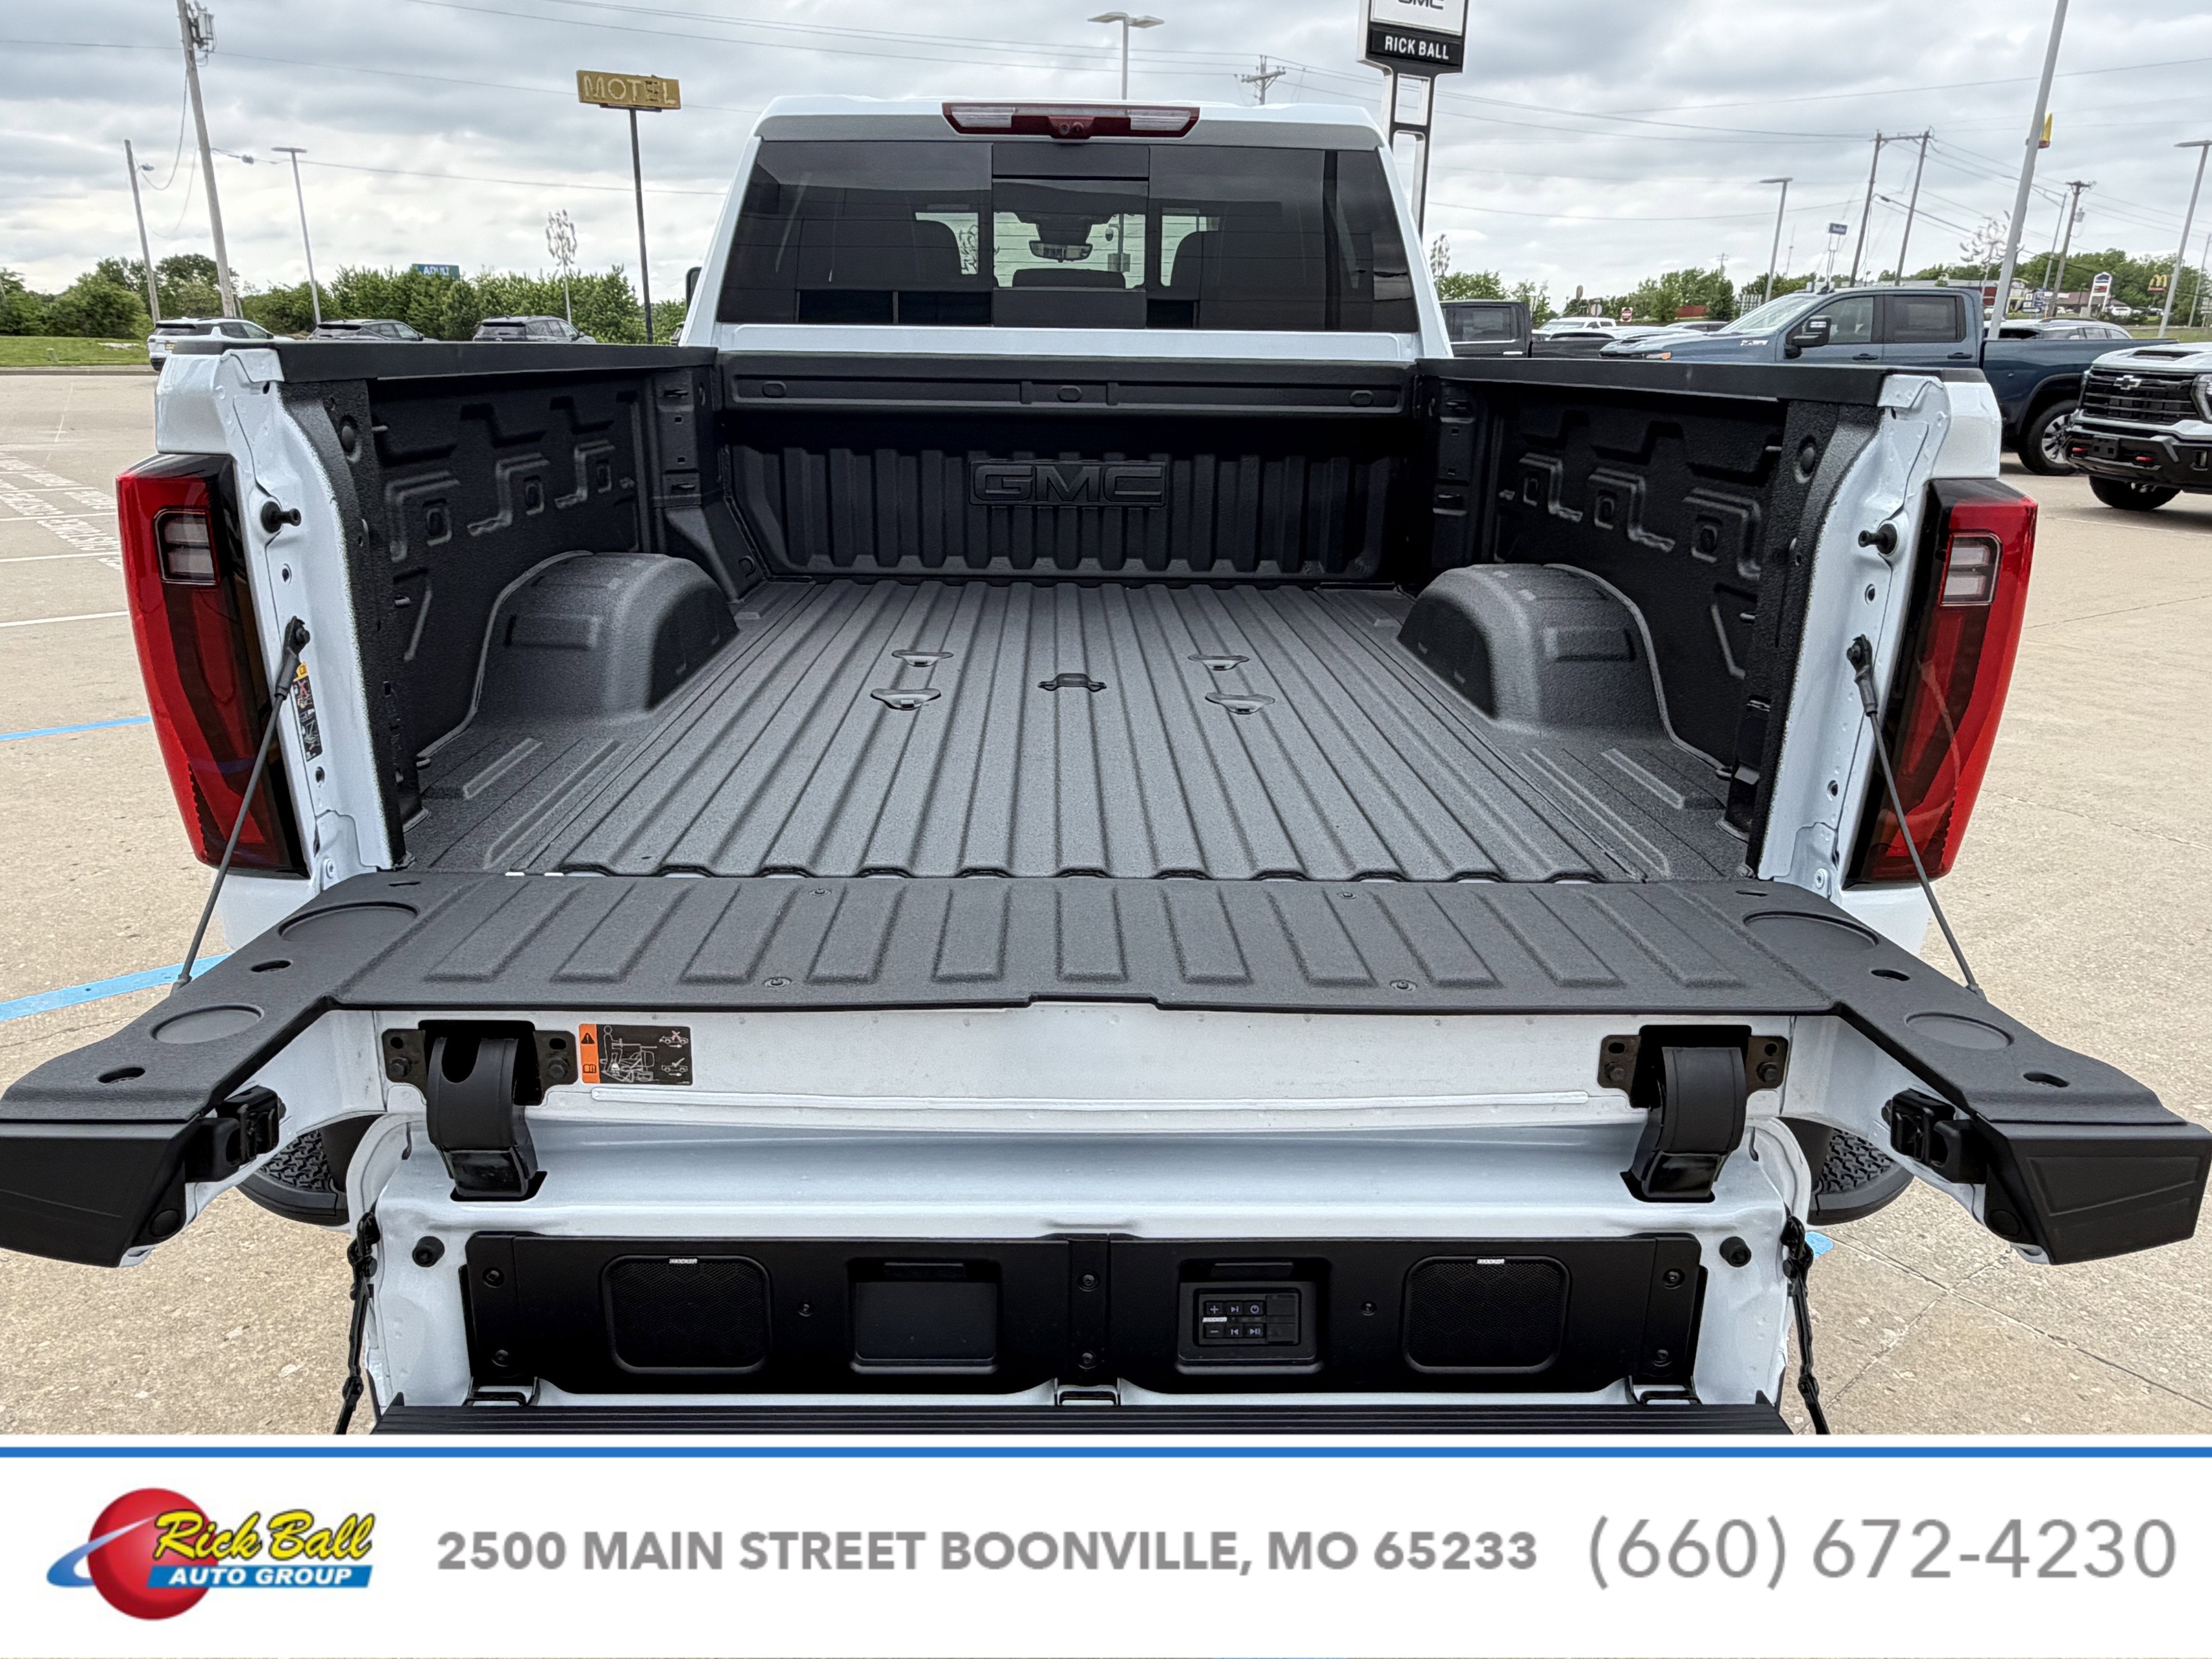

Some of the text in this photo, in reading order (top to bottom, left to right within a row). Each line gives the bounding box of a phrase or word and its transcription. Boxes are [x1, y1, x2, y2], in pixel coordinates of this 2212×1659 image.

[1384, 35, 1449, 60] RICK BALL
[973, 465, 1162, 503] GMC
